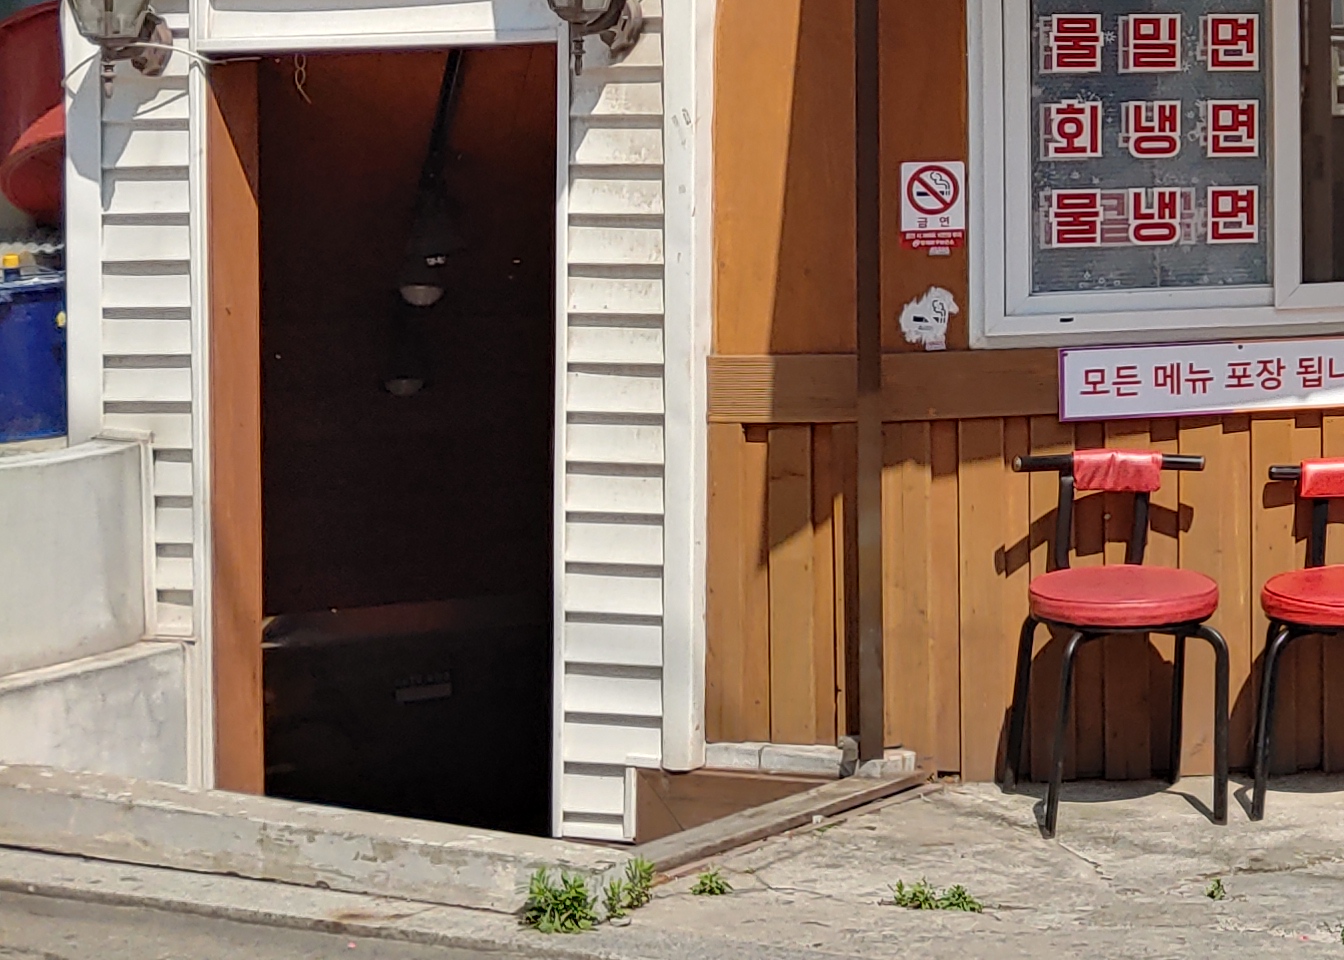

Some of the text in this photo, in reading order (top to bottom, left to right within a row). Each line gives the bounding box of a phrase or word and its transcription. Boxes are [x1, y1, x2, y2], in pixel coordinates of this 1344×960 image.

[1079, 365, 1143, 397] 모든
[1153, 363, 1215, 396] 메뉴
[1224, 357, 1287, 392] 포장
